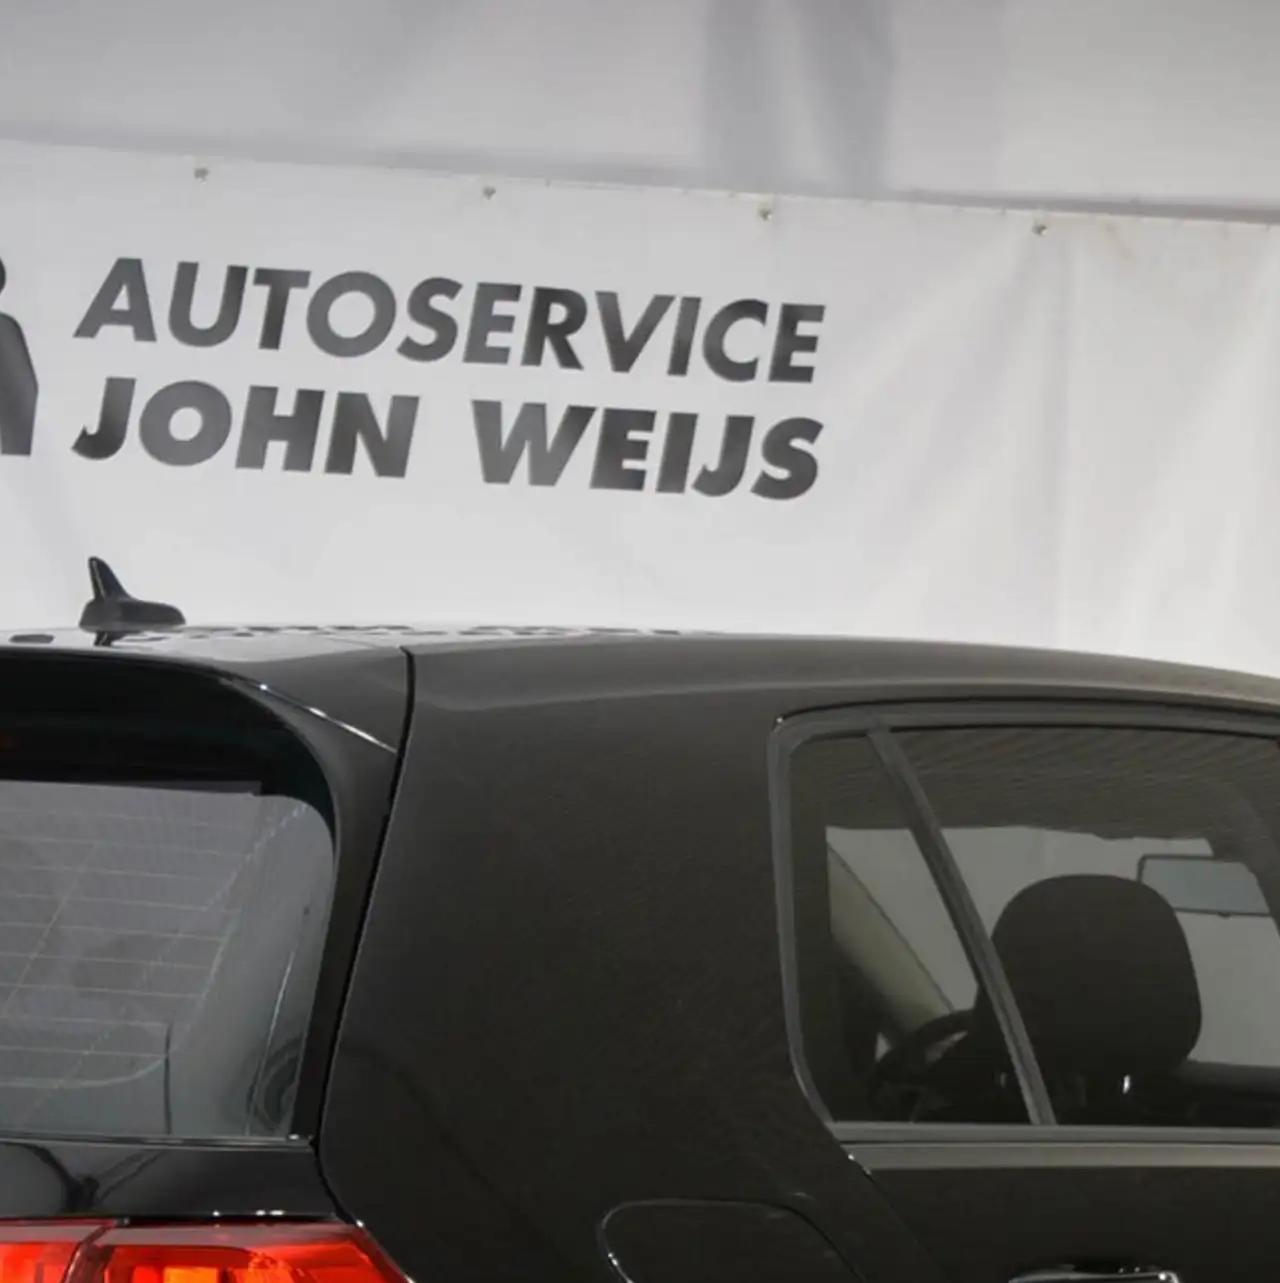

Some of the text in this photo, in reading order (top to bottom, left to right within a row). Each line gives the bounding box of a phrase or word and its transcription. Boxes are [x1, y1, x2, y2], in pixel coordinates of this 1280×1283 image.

[73, 257, 827, 383] AUTOSERVICE
[72, 377, 825, 501] JOHN WEIJS
